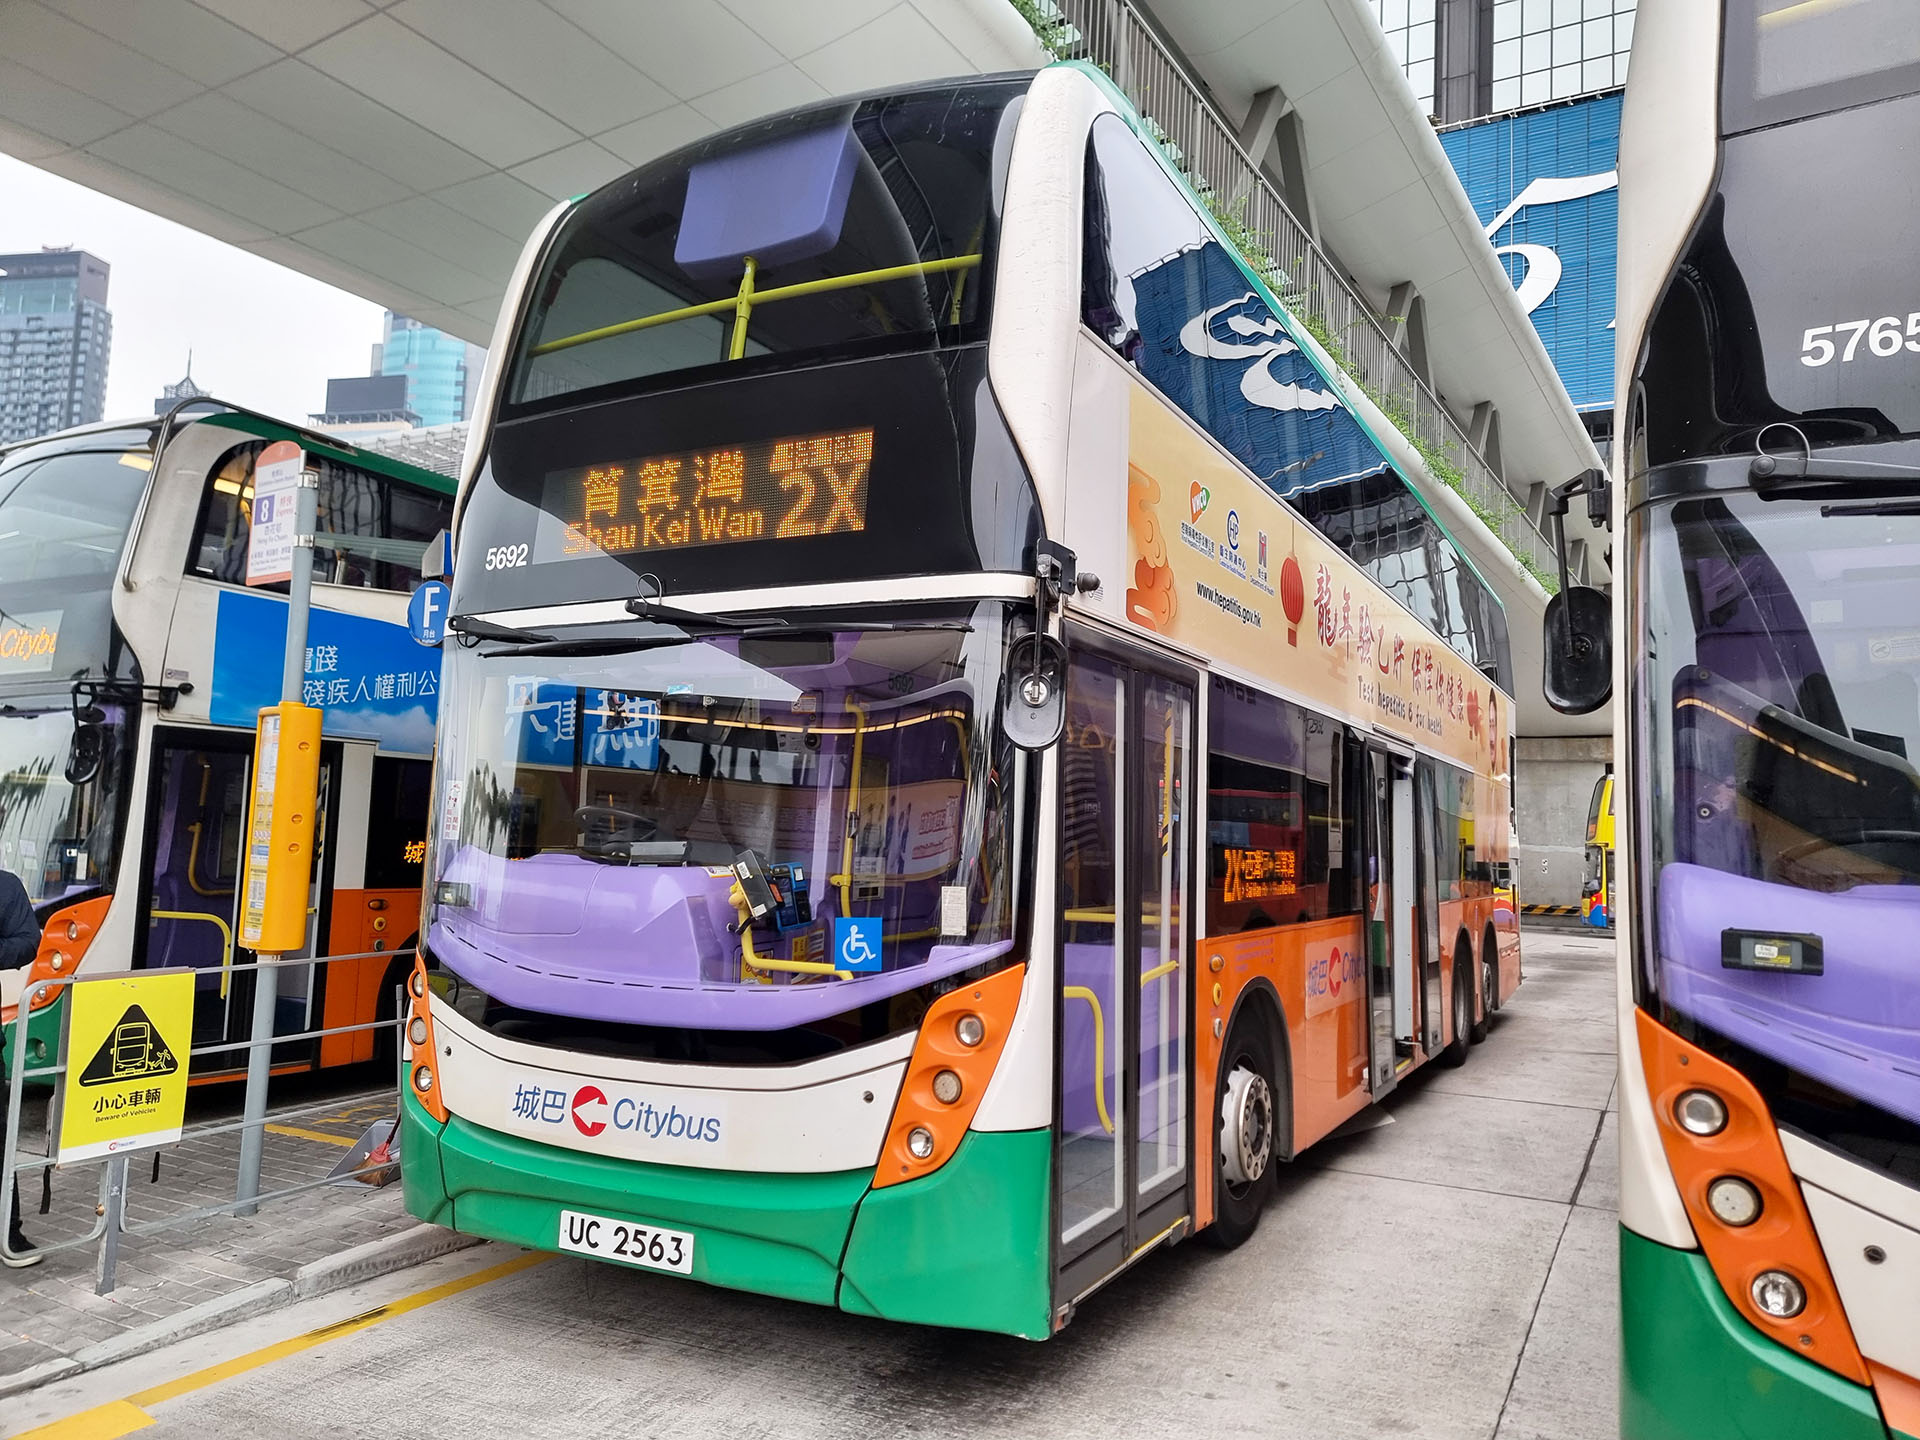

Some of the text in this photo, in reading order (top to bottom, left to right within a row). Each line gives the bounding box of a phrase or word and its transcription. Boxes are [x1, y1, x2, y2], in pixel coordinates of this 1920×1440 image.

[583, 450, 744, 519] 筲箕灣
[776, 461, 872, 538] 2X
[260, 499, 270, 523] 8
[564, 507, 763, 553] Shau Kei Wan
[485, 544, 528, 571] 5692
[423, 586, 440, 628] F
[1196, 581, 1262, 628] www.hepatitis.gov.hk
[1358, 675, 1374, 704] Test
[403, 840, 425, 863] 城
[92, 1088, 161, 1113] 小心車輛
[95, 1114, 121, 1123] Beware
[130, 1107, 156, 1117] Vehicles
[512, 1084, 567, 1124] 城巴
[613, 1098, 721, 1143] Citybus
[568, 1216, 684, 1266] UC 2563
